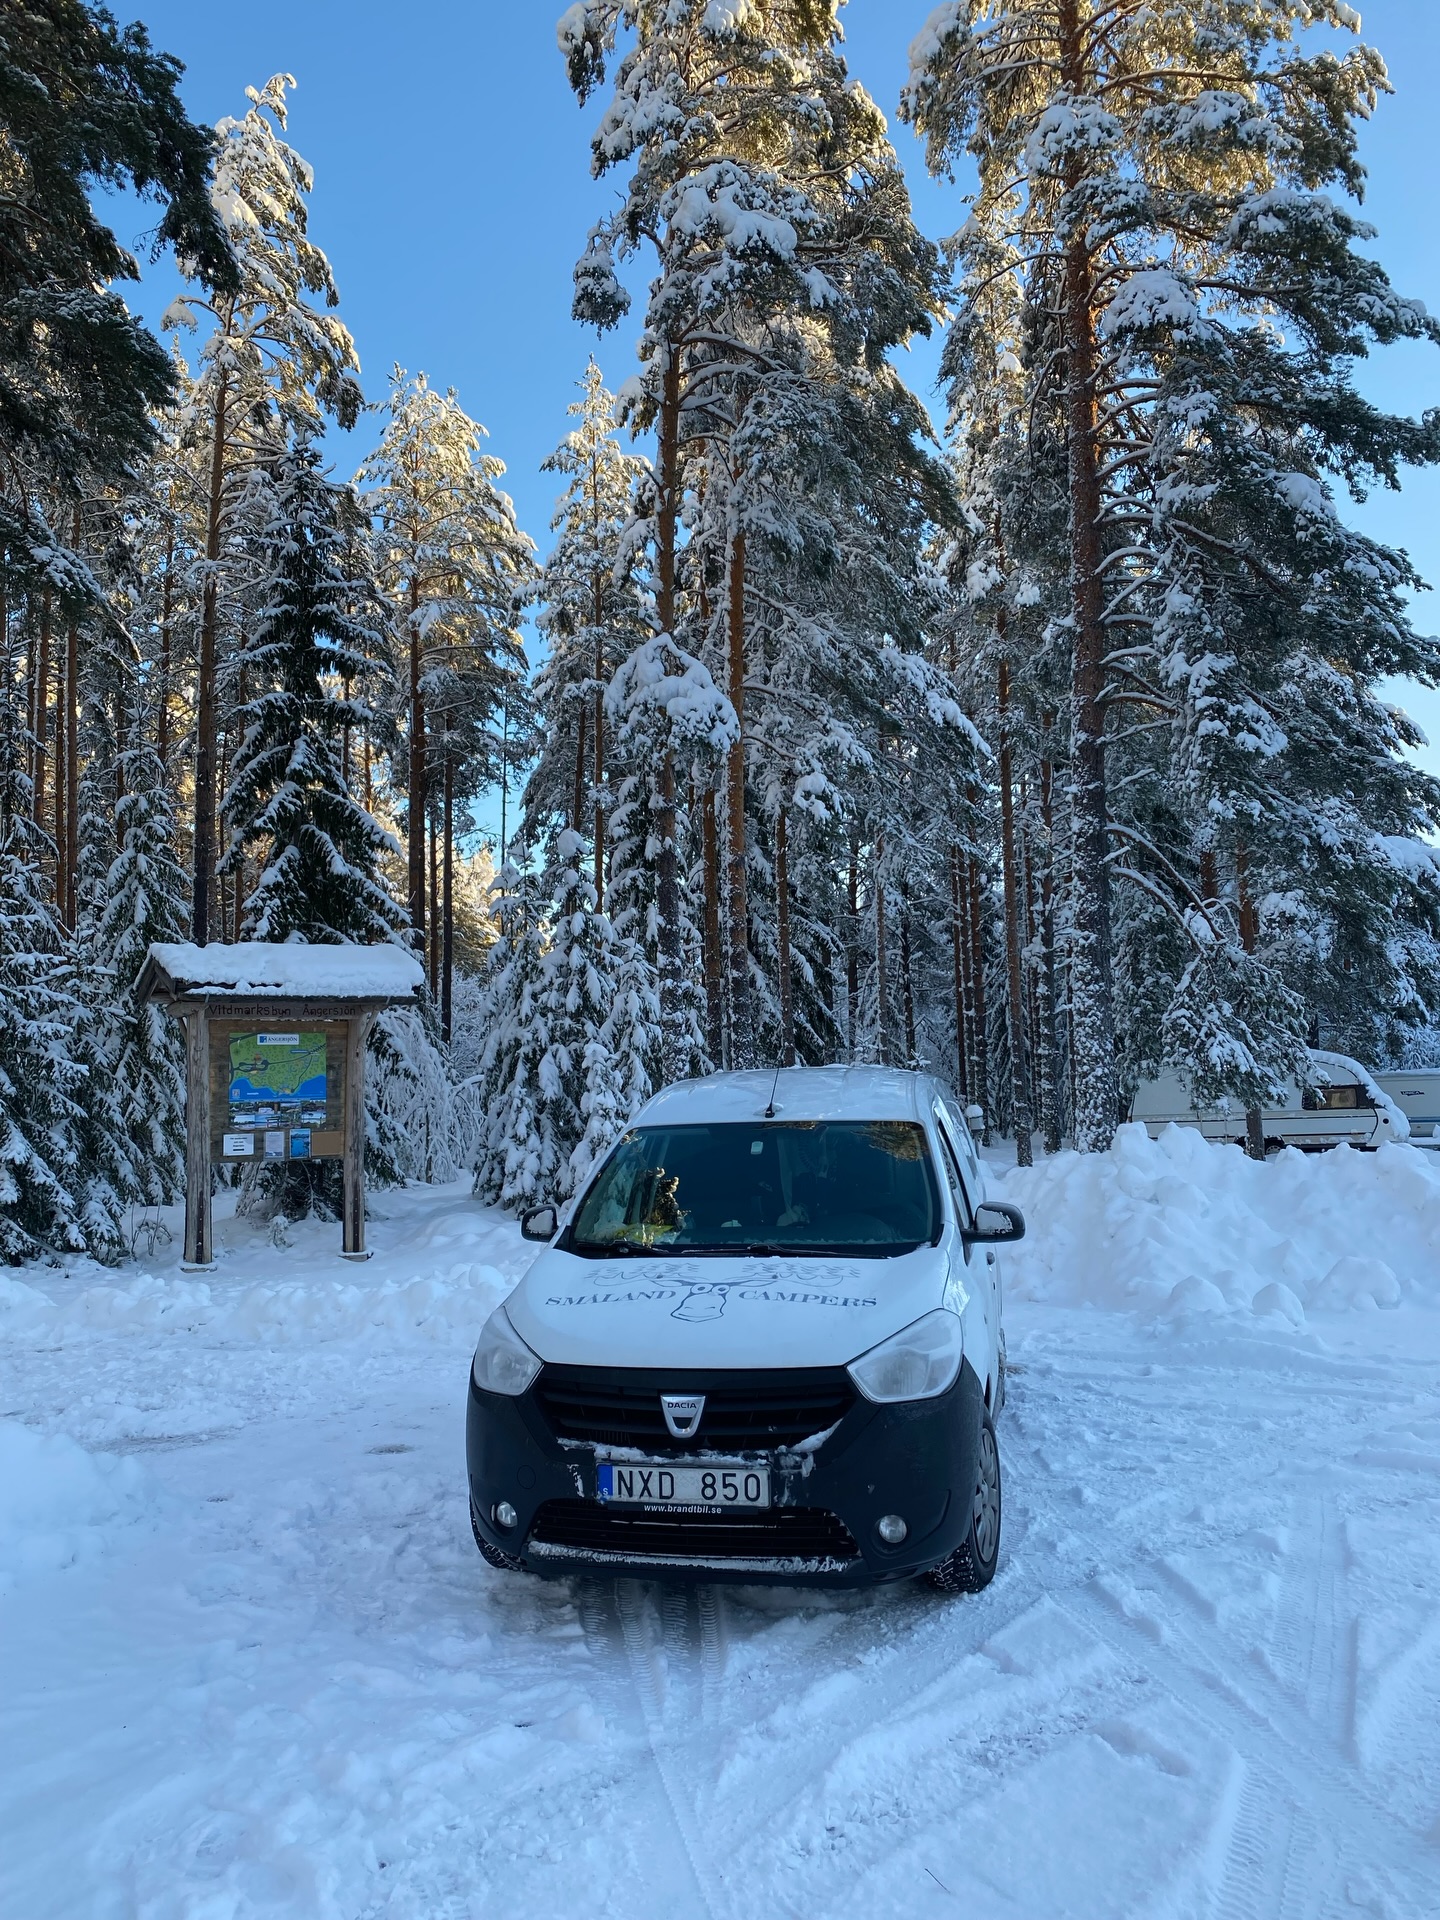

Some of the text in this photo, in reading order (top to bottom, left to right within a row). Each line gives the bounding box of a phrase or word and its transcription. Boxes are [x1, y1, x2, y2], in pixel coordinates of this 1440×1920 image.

[545, 1290, 878, 1307] SMÅLAND CAMPERS
[602, 1487, 609, 1496] S
[617, 1470, 761, 1502] NXD 850
[643, 1504, 722, 1515] www.brandtbil.se
